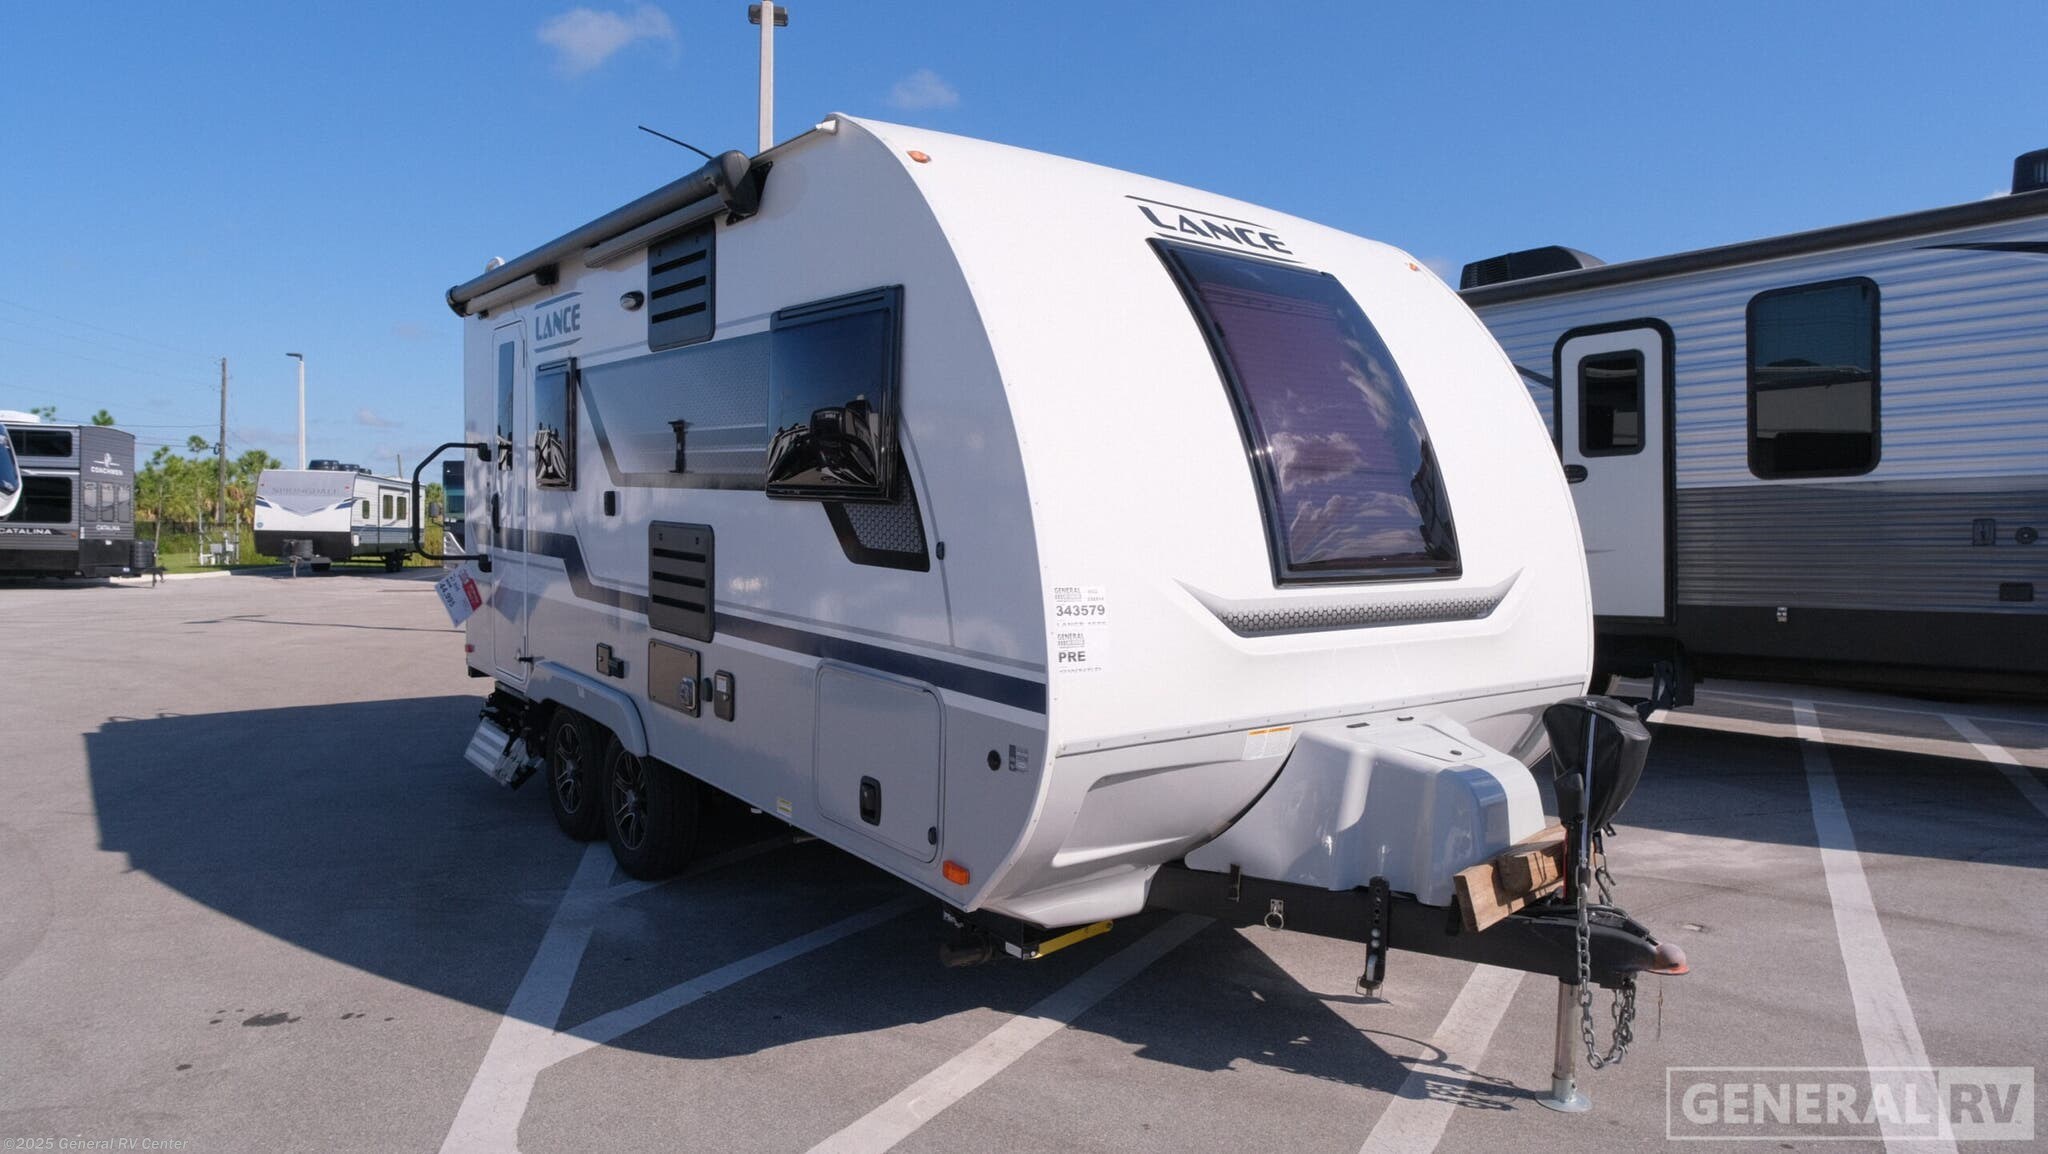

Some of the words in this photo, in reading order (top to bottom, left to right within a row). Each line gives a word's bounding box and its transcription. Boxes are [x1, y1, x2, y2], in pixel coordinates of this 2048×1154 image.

[1138, 205, 1293, 254] LANCE
[536, 303, 581, 341] LANCE
[1056, 604, 1105, 616] 343579
[1058, 651, 1086, 662] PRE
